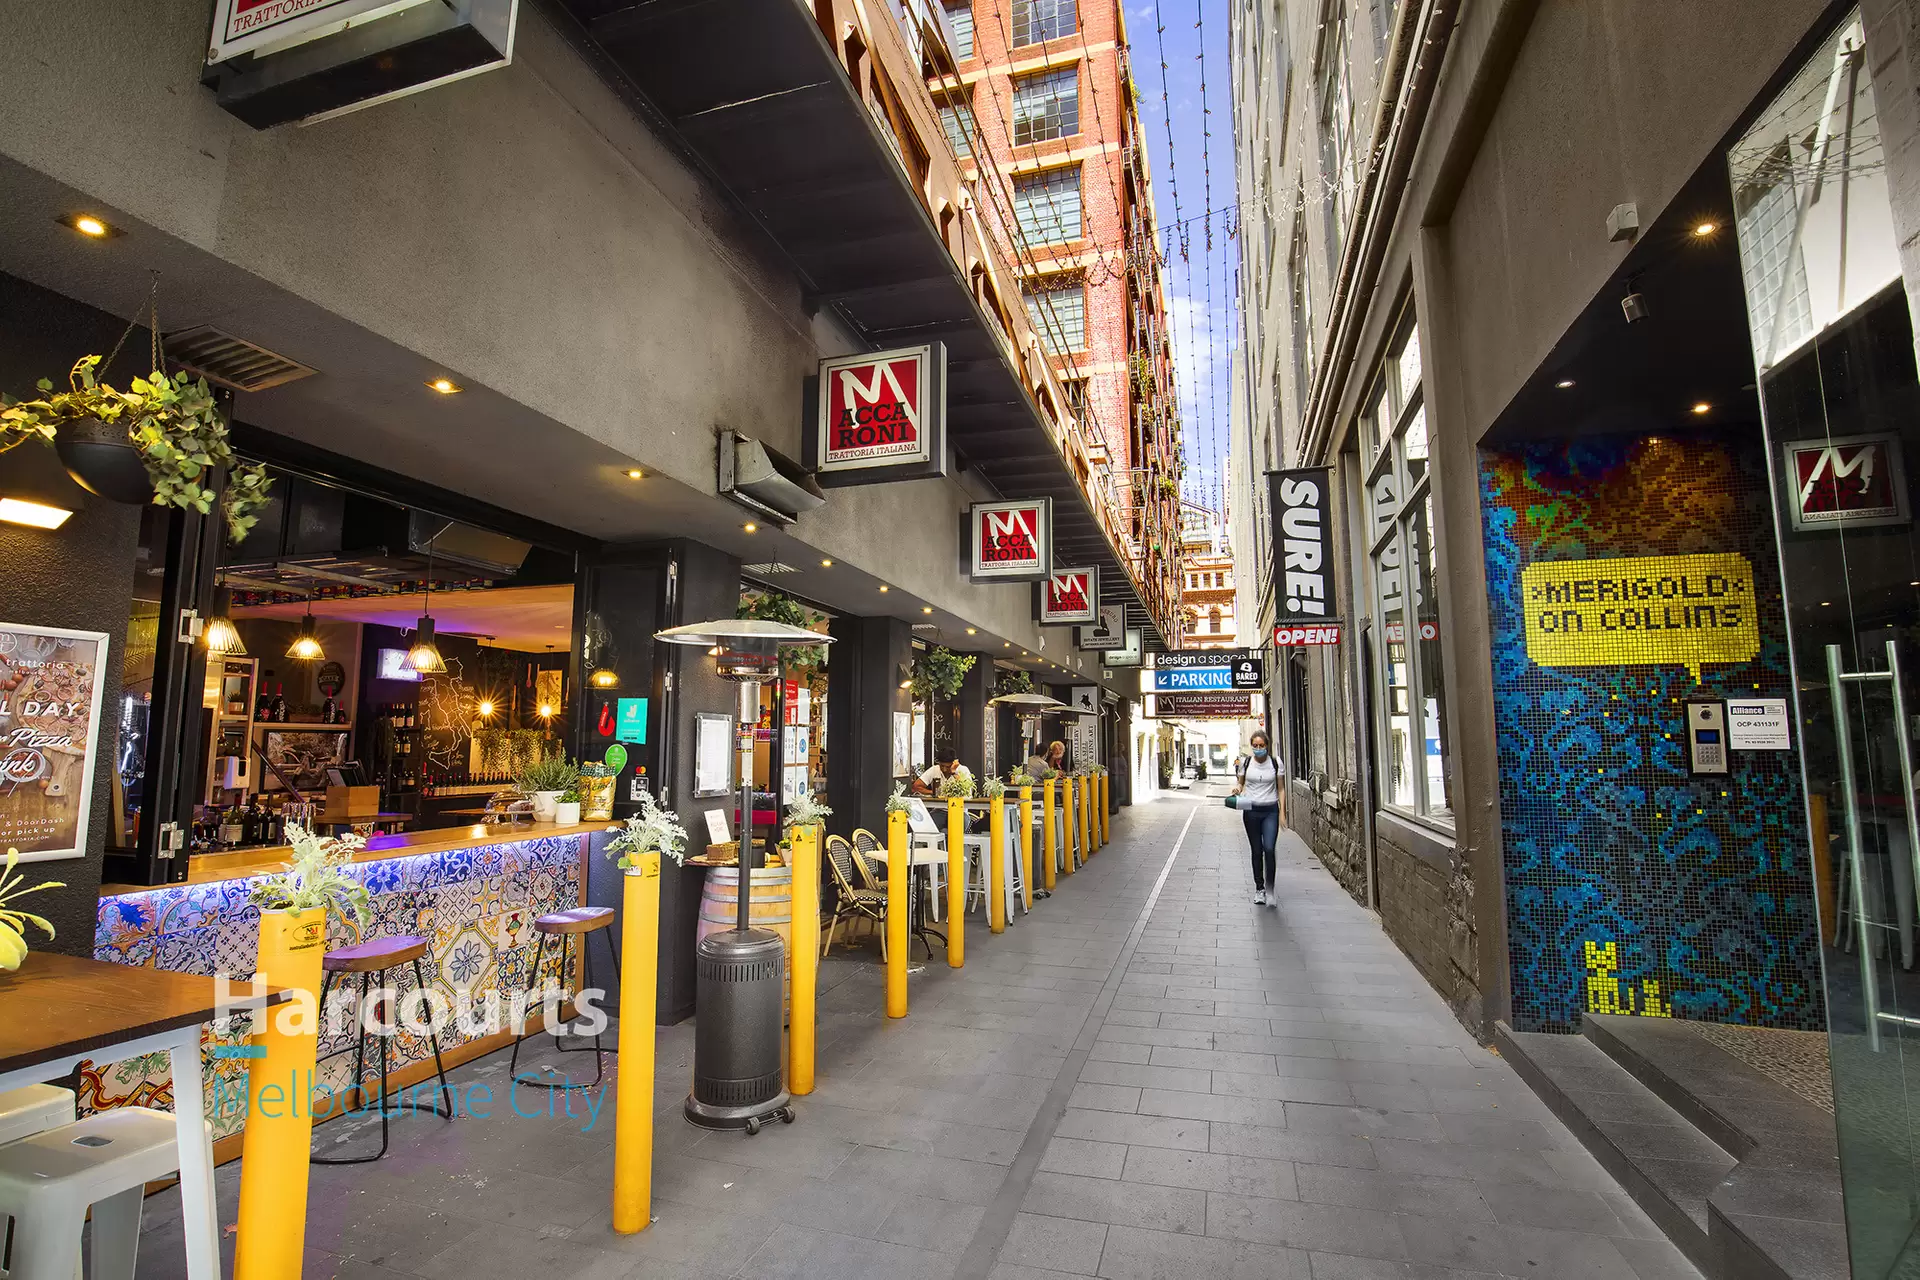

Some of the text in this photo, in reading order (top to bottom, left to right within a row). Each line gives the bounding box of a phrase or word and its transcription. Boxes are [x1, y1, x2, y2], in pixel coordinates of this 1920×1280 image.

[838, 402, 909, 427] ACCA
[838, 422, 909, 448] RONI
[829, 443, 917, 460] TRATTORIA ITALIANA
[985, 534, 1032, 548] ACCA
[1280, 477, 1325, 615] SURE!
[985, 548, 1032, 561] RONI
[1276, 629, 1338, 645] OPEN!
[6, 659, 65, 669] trattoria
[1157, 653, 1196, 666] design
[1198, 655, 1207, 664] a
[1171, 672, 1232, 686] PARKING
[1235, 672, 1258, 681] BARED
[1204, 695, 1249, 703] RESTAURANT
[24, 701, 81, 717] DAY
[1732, 707, 1763, 715] Alliance
[8, 728, 73, 748] Pizza
[17, 818, 65, 827] DoorDash
[16, 827, 39, 836] pick
